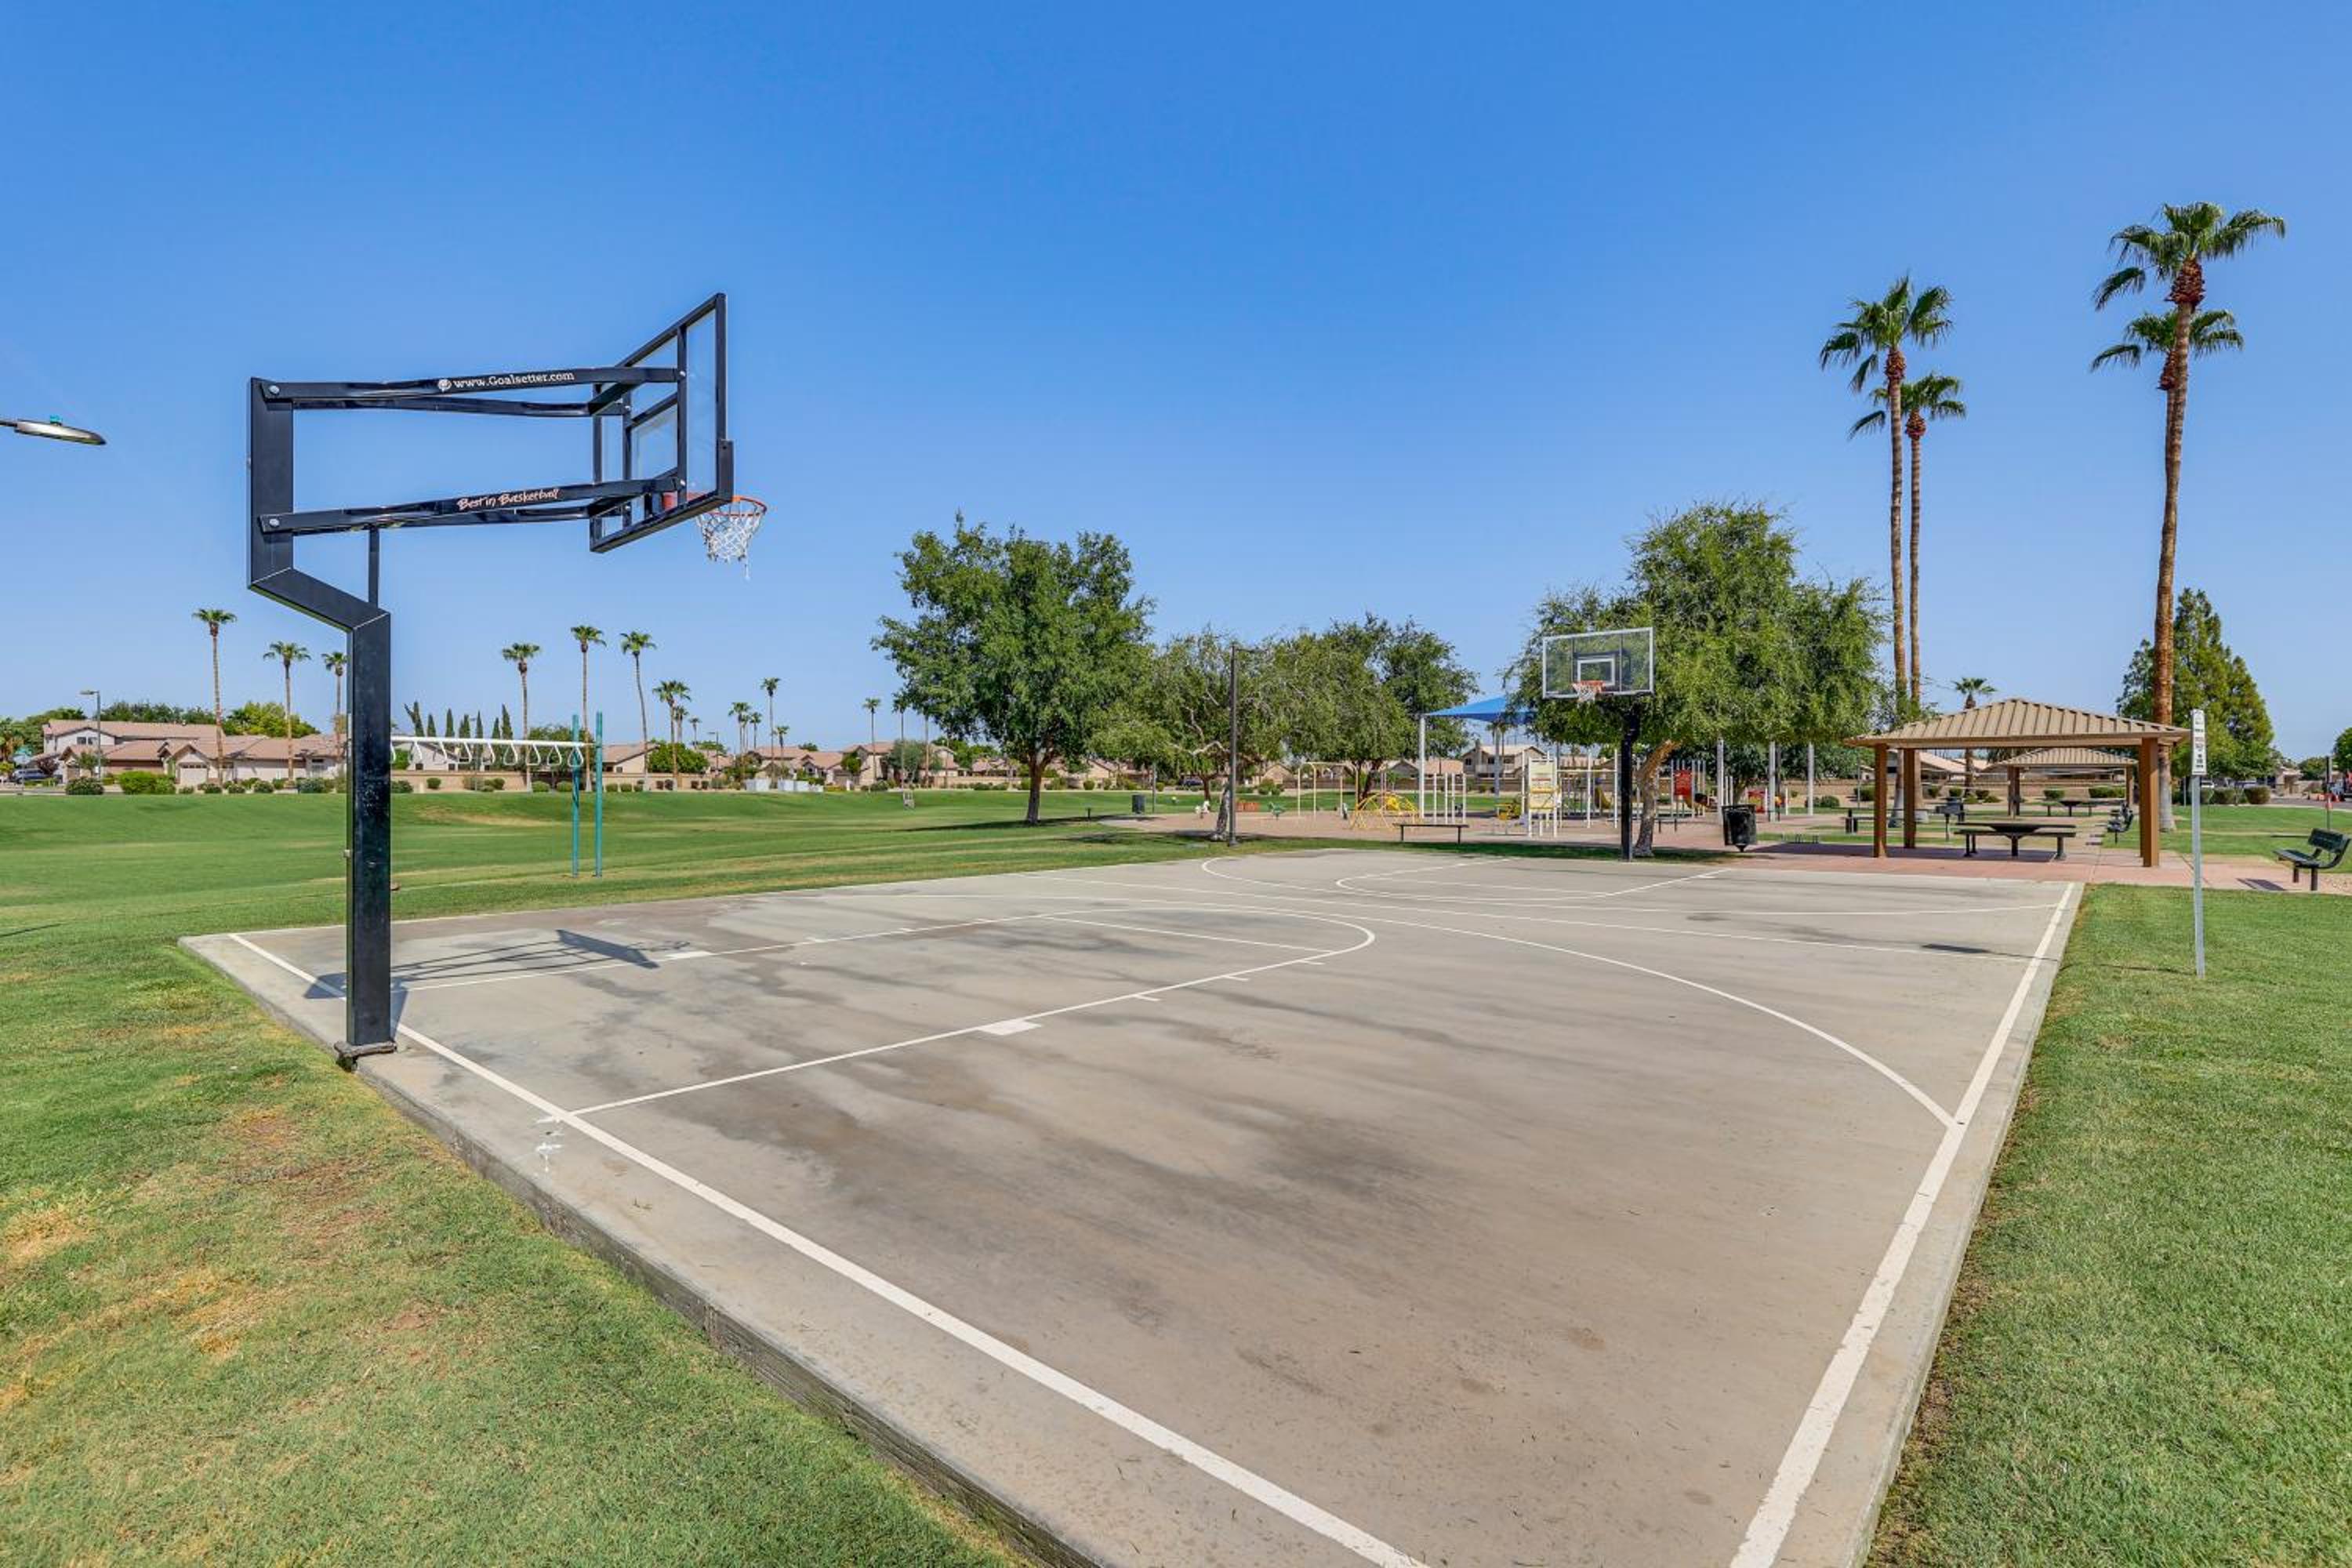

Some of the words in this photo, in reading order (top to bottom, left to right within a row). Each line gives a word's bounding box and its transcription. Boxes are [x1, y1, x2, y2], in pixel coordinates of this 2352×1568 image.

[452, 372, 575, 389] www.Goalsetter.com
[456, 496, 485, 510] Best
[485, 496, 496, 507] in
[498, 488, 560, 506] Basketball
